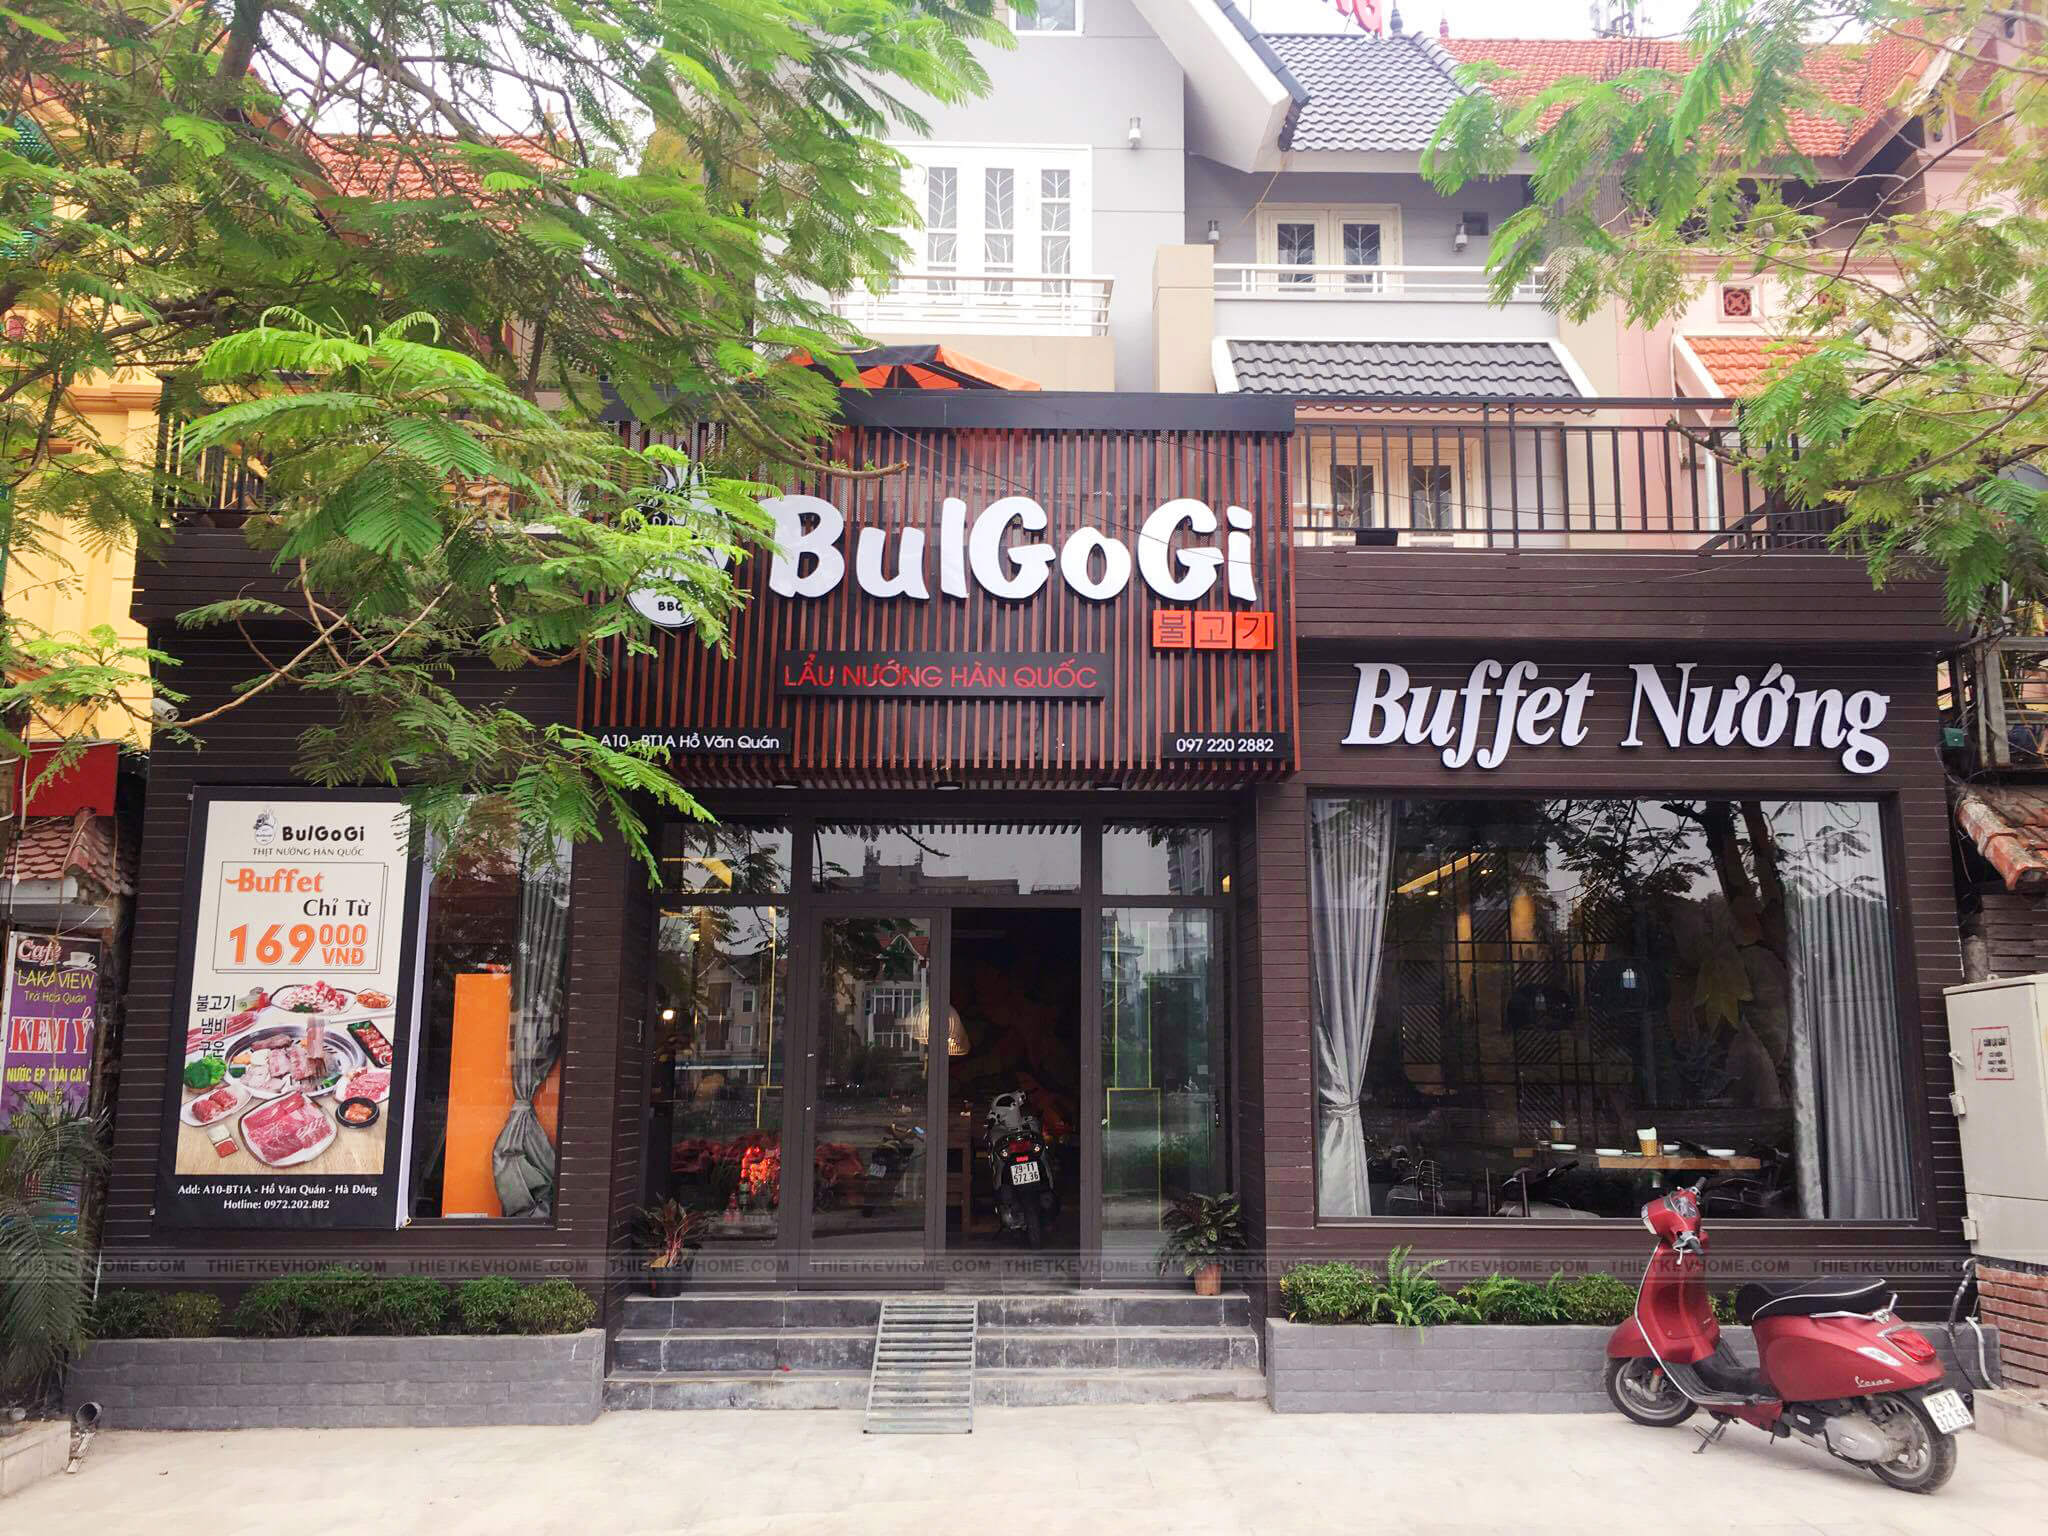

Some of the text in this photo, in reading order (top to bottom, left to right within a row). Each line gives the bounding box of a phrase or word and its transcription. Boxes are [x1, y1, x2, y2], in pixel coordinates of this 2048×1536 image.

[759, 495, 1257, 600] BulGoGi
[1158, 613, 1268, 647] 불고기
[784, 653, 1098, 688] LẨU NƯỚNG HÀN QUỐC
[1341, 659, 1890, 773] Buffet Nướng
[600, 734, 628, 748] A10
[704, 735, 734, 748] Văn
[737, 734, 780, 749] Quán
[1176, 738, 1274, 752] 097 220 2882
[282, 825, 364, 841] BulGoGi
[225, 868, 325, 892] Buffet
[303, 898, 371, 916] Chỉ Từ
[229, 922, 367, 966] 169 000
[322, 947, 365, 966] VNĐ
[196, 995, 236, 1012] 불고기
[9, 1017, 68, 1053] KEM
[199, 1040, 225, 1058] 구운
[178, 1184, 200, 1195] Add:
[203, 1184, 251, 1194] A10-BT1A
[224, 1199, 329, 1209] Hotline: 0972.202.882
